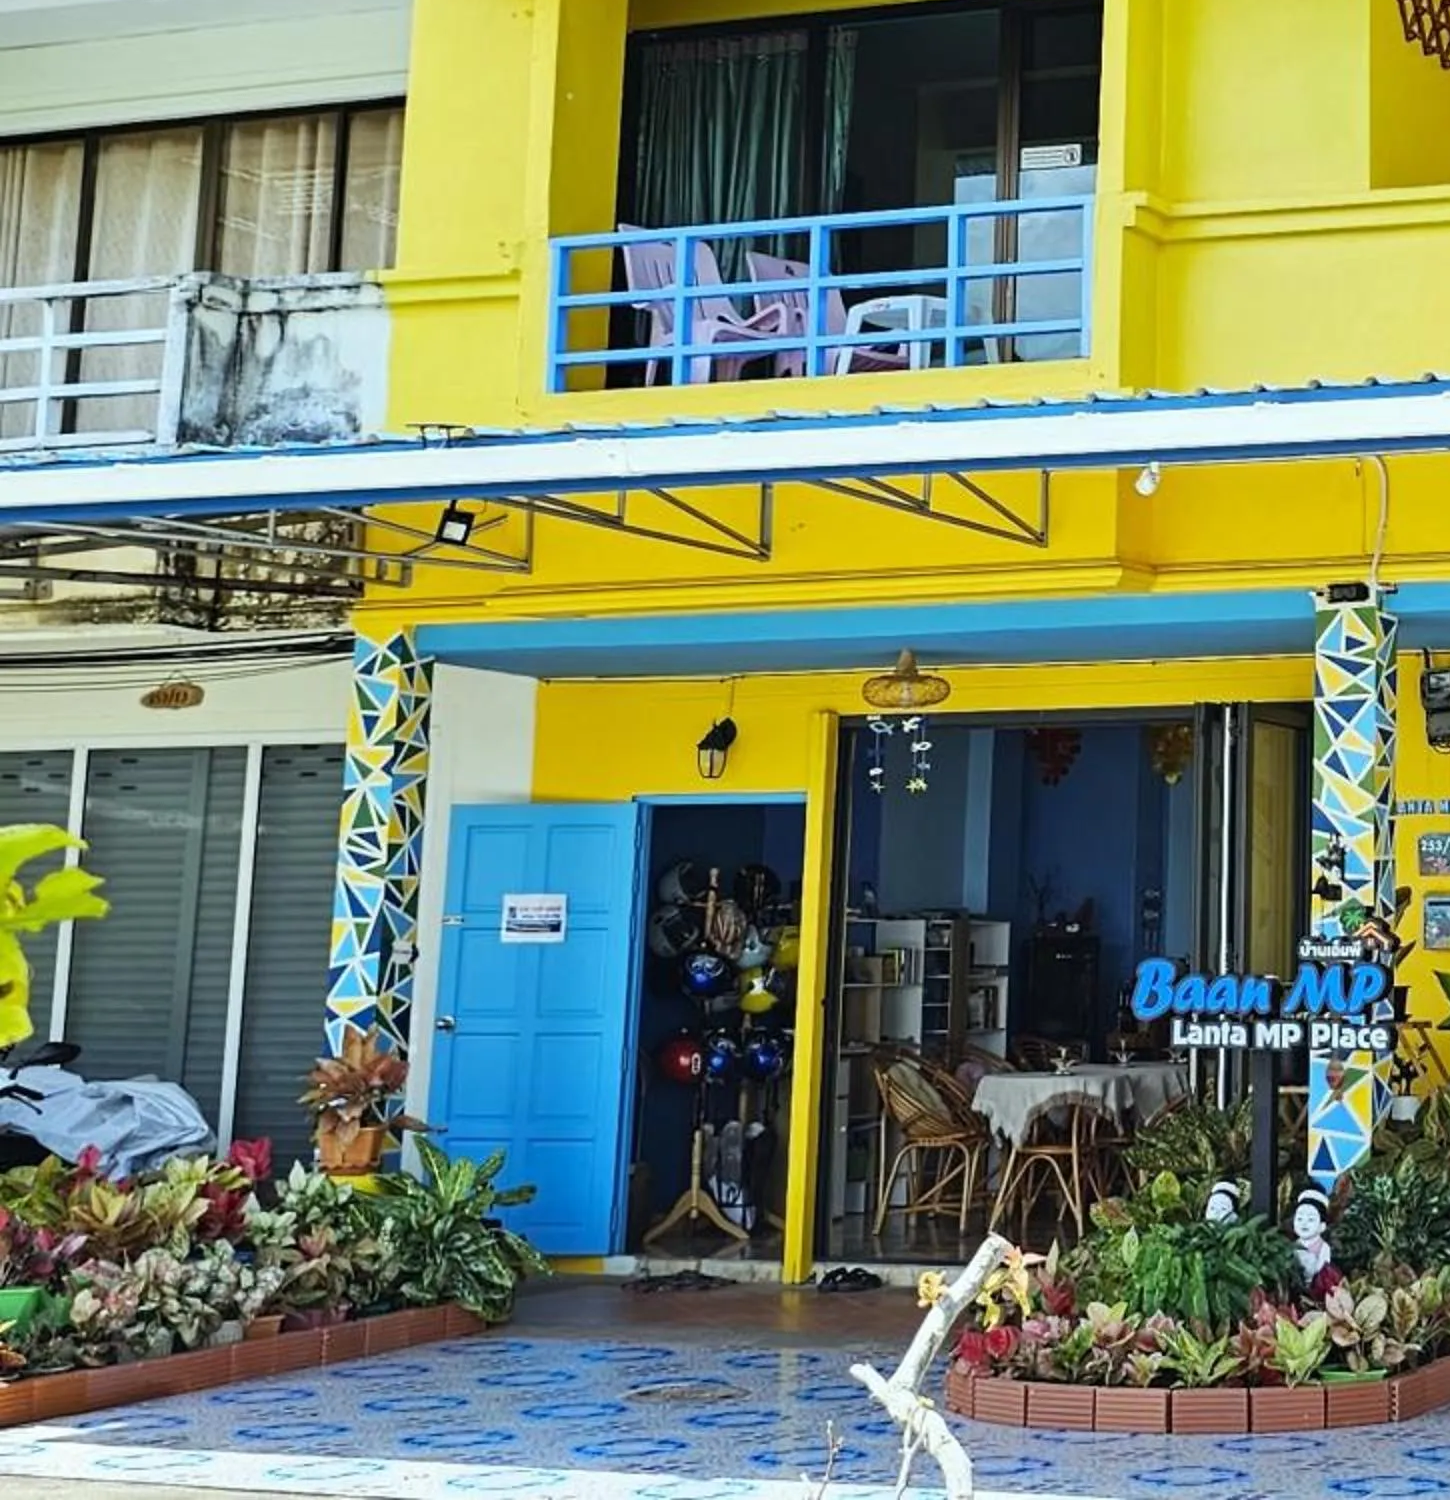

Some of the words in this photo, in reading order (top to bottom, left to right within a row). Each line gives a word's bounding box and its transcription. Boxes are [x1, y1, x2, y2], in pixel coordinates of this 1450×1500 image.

[1396, 799, 1434, 814] ANTA
[1132, 958, 1272, 1020] Baan
[1284, 963, 1386, 1015] MP
[1172, 1019, 1247, 1047] Lanta
[1255, 1023, 1302, 1049] MP
[1311, 1022, 1390, 1049] Place
